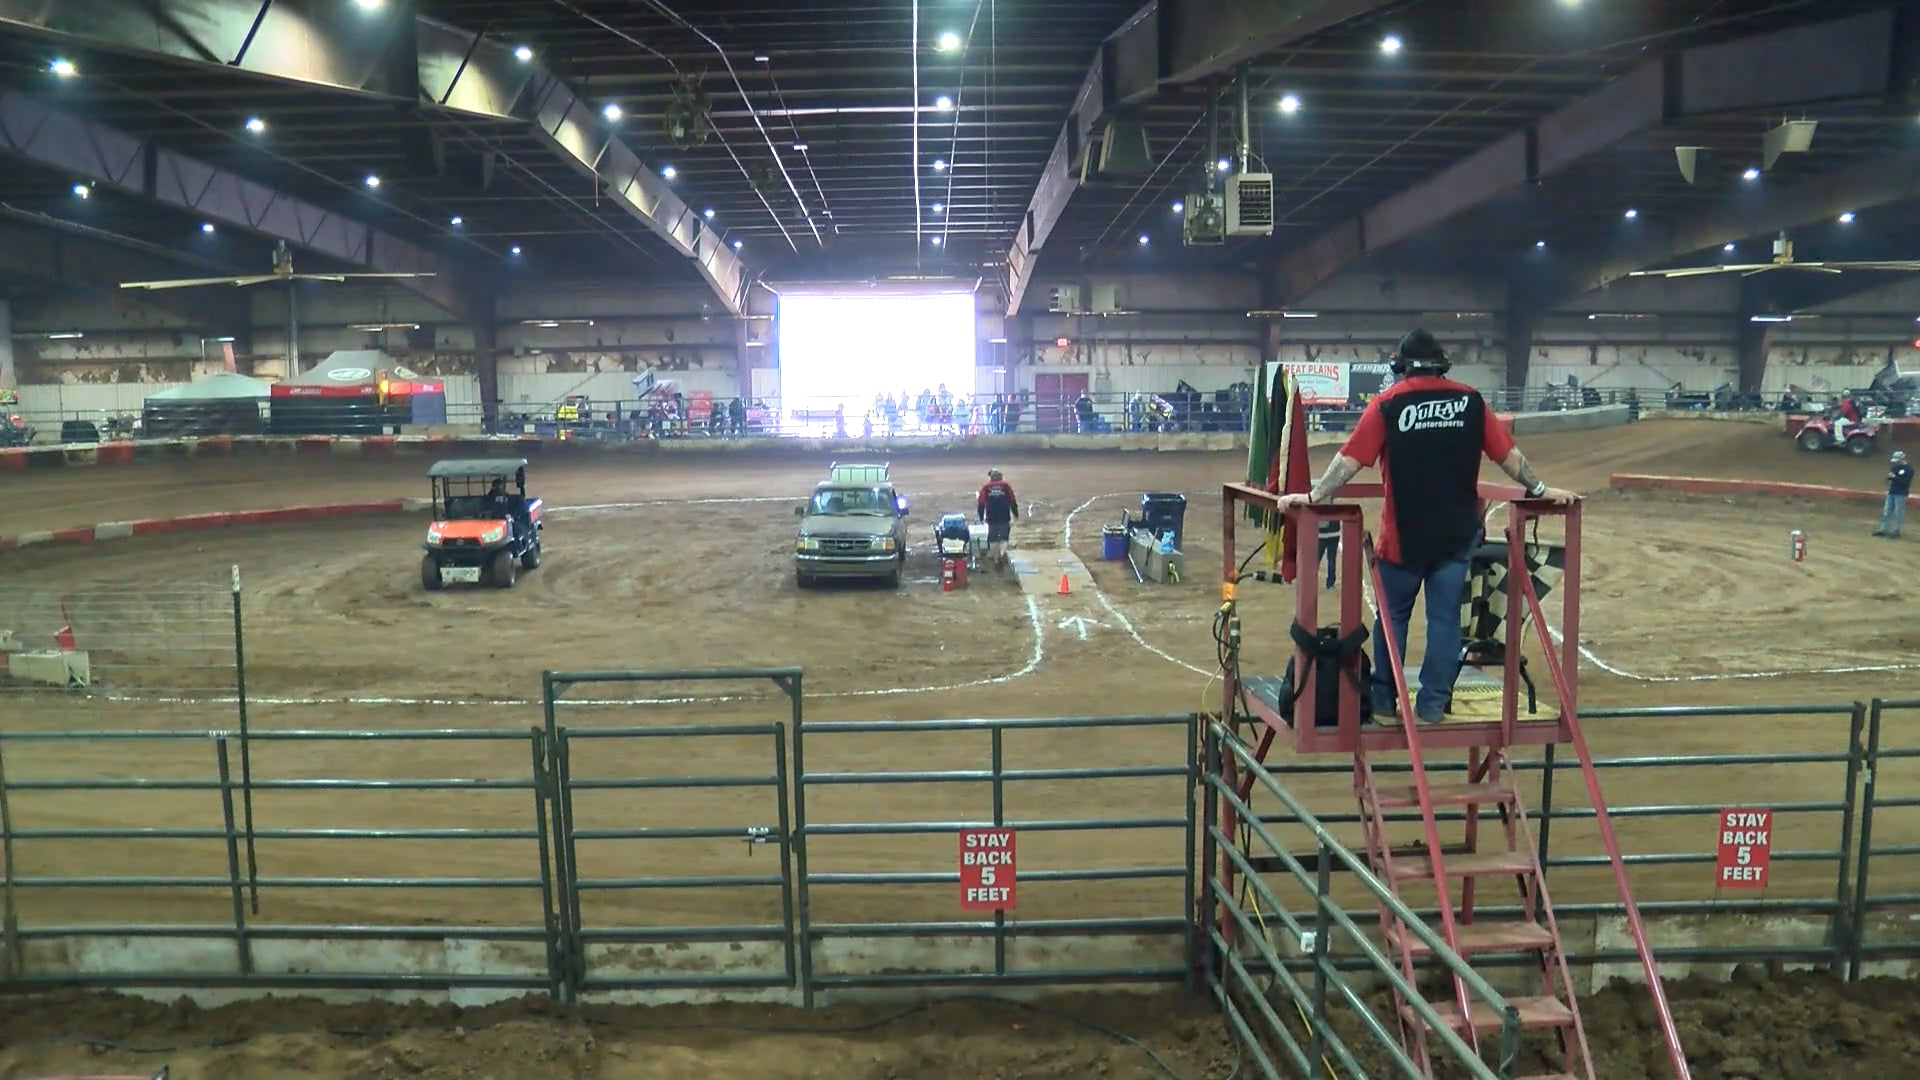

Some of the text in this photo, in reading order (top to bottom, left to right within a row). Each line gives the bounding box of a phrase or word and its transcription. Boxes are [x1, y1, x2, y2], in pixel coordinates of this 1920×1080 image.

[1284, 364, 1305, 375] REAT
[1308, 364, 1339, 381] PLAINS
[1414, 420, 1465, 430] Motorsports
[1726, 813, 1767, 827] STAY
[966, 833, 1010, 847] STAY
[1722, 831, 1768, 845] BACK
[963, 851, 1012, 865] BACK
[1737, 846, 1751, 865] 5
[981, 866, 996, 885] 5
[1723, 866, 1763, 880] FEET
[967, 887, 1010, 902] FEET
